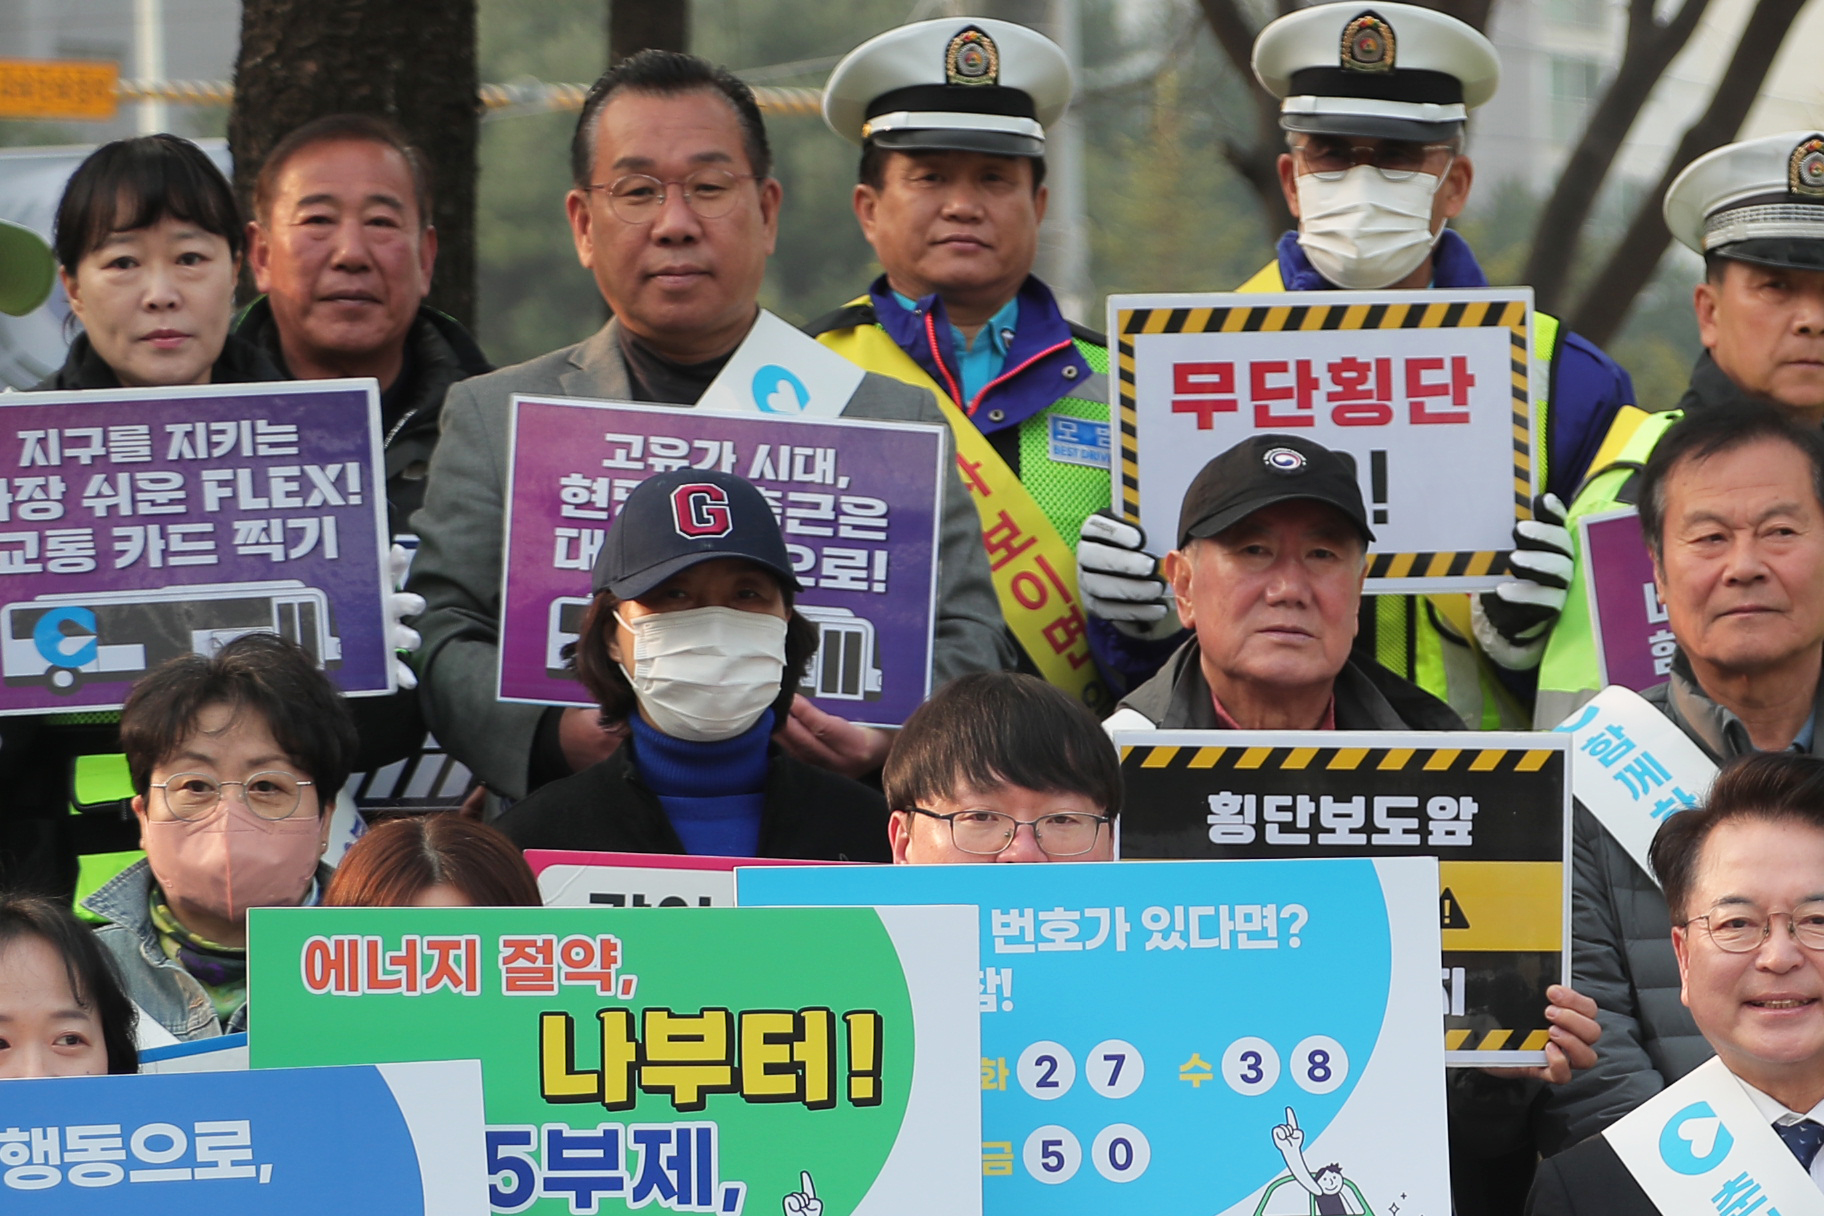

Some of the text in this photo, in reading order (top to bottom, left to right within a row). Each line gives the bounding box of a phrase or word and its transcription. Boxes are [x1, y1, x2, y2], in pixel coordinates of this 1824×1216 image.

[1171, 355, 1476, 431] 무단횡단
[17, 418, 300, 469] 지구를 지키는
[748, 444, 851, 489] 시대,
[81, 469, 188, 519] 쉬운
[201, 461, 363, 513] FLEX!
[670, 482, 734, 540] G
[0, 515, 339, 575] 교통 카드 찍기
[1207, 791, 1479, 847] 횡단보도앞
[990, 903, 1310, 954] 번호가 있다면?
[301, 933, 639, 1000] 에너지 절약,
[538, 1006, 886, 1112] 나부터!
[1033, 1054, 1060, 1089] 2
[1103, 1053, 1127, 1087] 7
[1178, 1053, 1214, 1089] 수
[1239, 1049, 1265, 1085] 3
[1305, 1048, 1333, 1083] 8
[0, 1119, 274, 1190] 행동으로,
[1040, 1138, 1066, 1173] 5
[1107, 1136, 1135, 1171] 0
